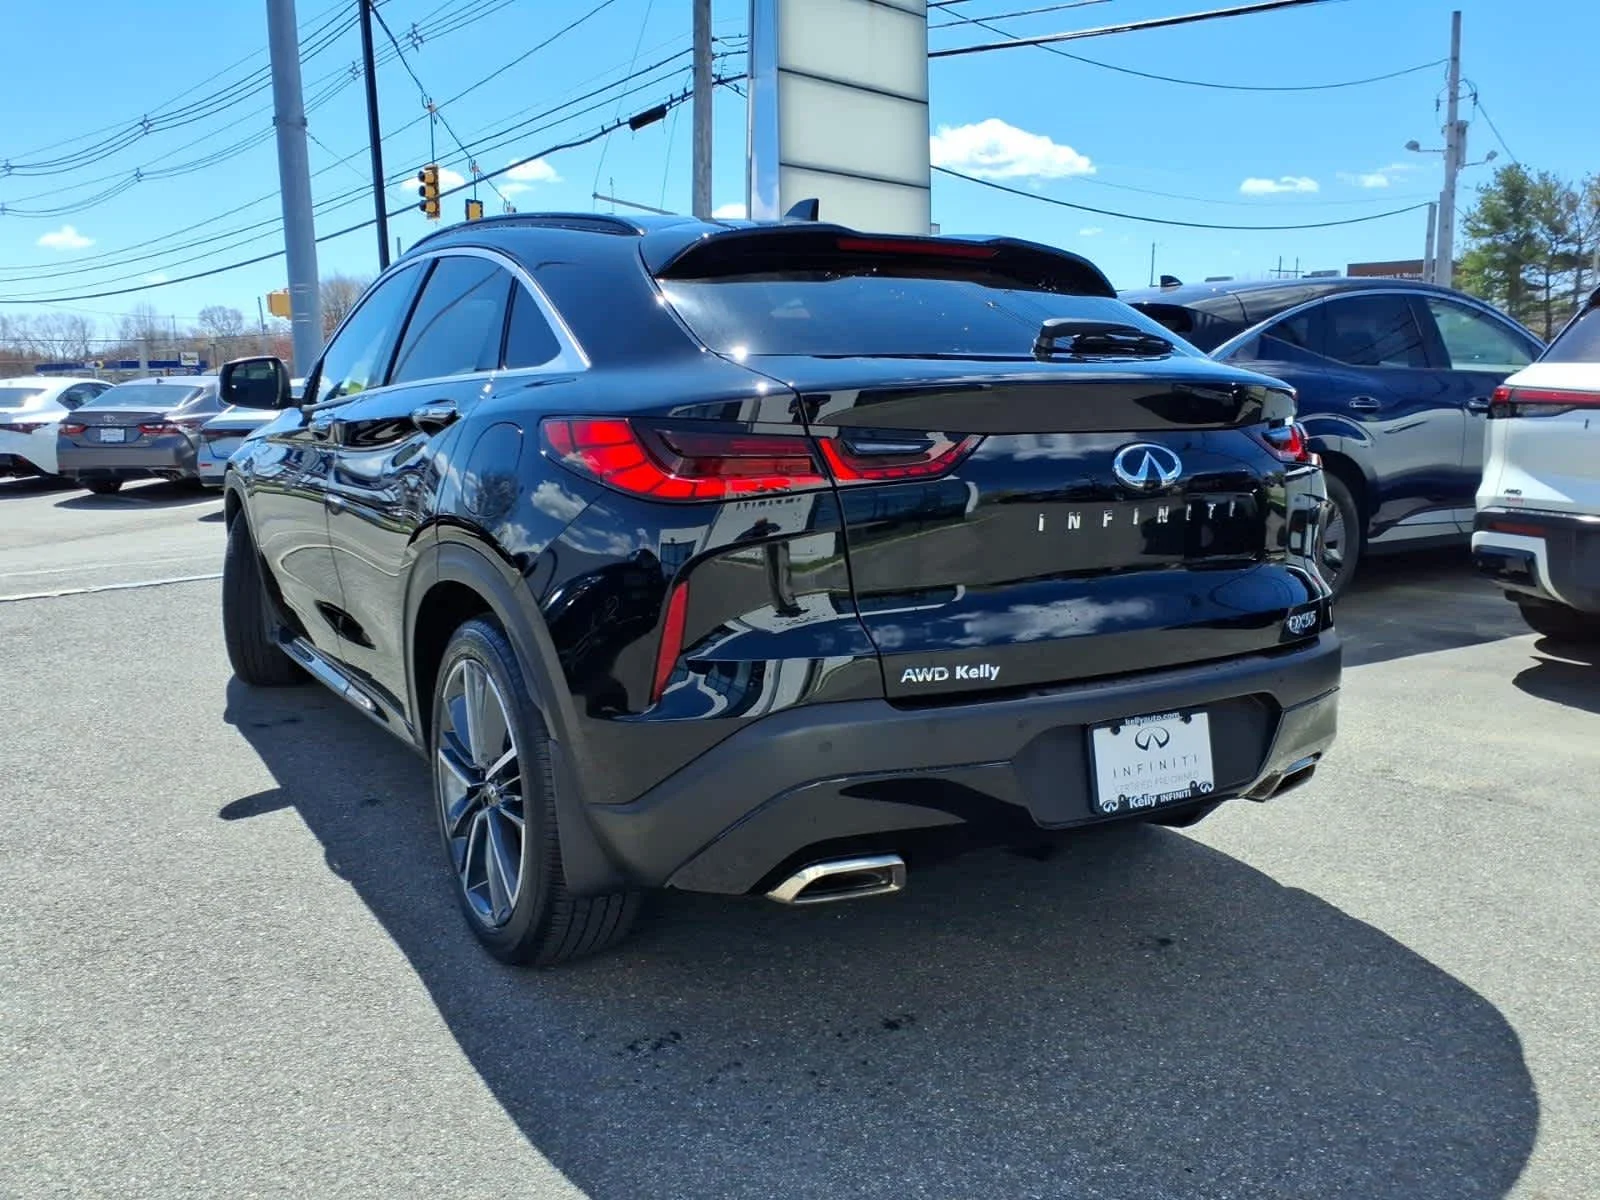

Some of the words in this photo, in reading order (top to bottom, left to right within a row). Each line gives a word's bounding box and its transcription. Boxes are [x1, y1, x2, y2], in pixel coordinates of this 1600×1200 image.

[1037, 501, 1236, 532] INFINITI
[900, 667, 949, 683] AWD
[955, 663, 1001, 681] Kelly
[1113, 754, 1198, 778] INFINITI
[1128, 794, 1157, 808] Kelly
[1160, 789, 1192, 802] INFINITI
